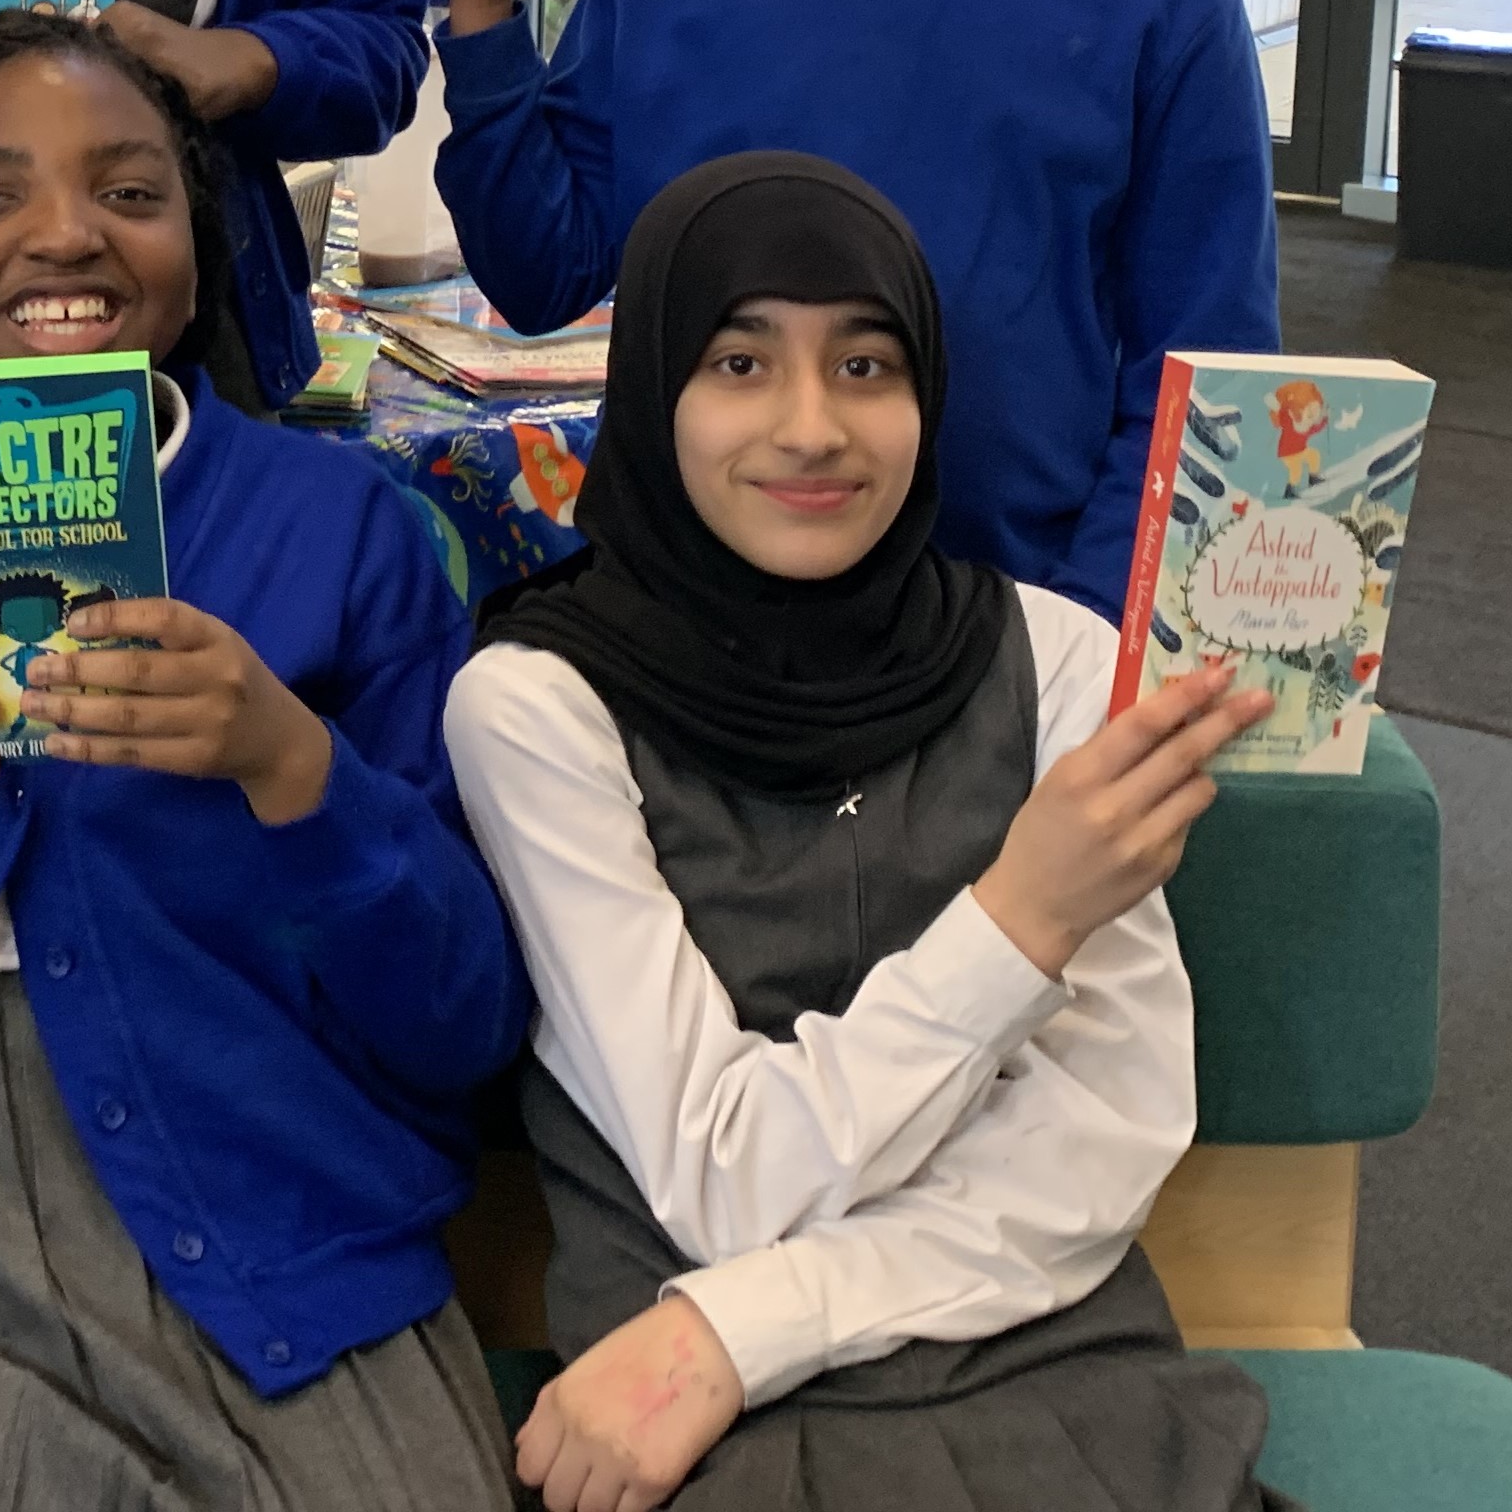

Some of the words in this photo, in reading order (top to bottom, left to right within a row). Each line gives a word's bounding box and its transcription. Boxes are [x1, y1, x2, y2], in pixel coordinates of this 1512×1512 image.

[21, 528, 54, 548] FOR
[59, 521, 128, 546] SCHOOL
[1246, 520, 1317, 560] Astrid
[1210, 558, 1342, 608] Unstoppable
